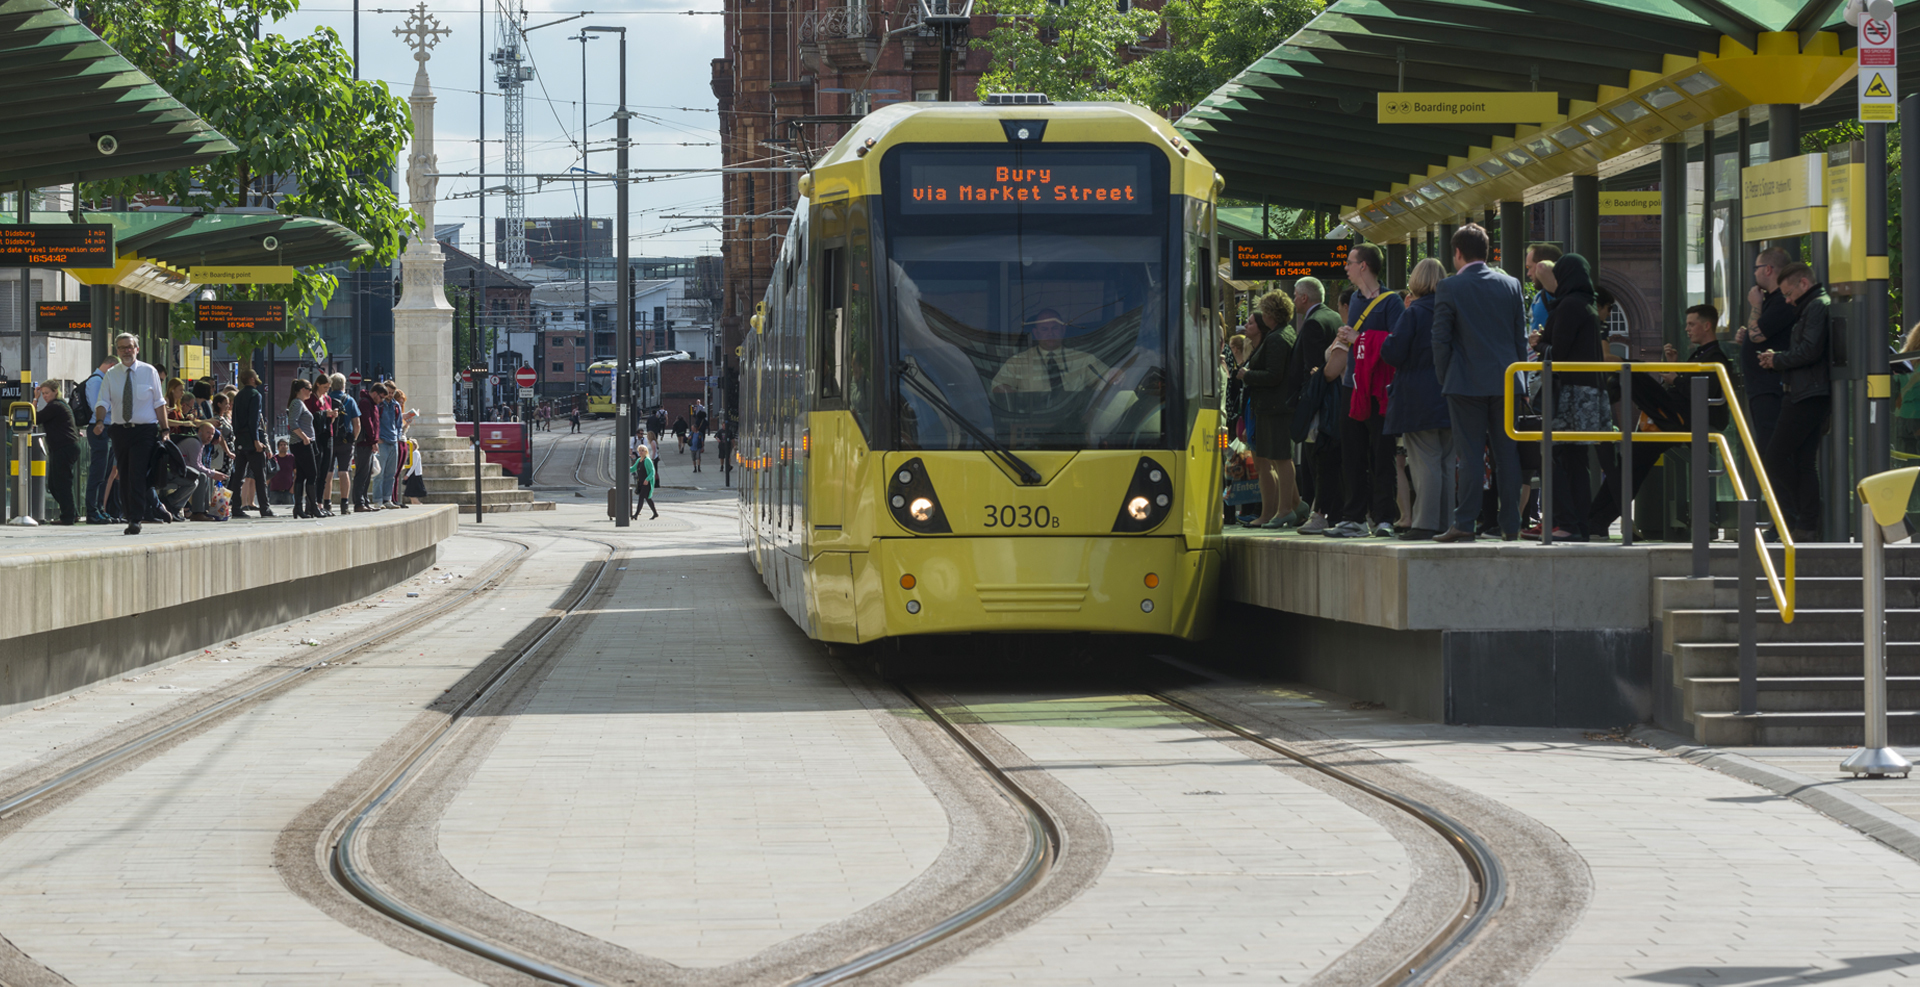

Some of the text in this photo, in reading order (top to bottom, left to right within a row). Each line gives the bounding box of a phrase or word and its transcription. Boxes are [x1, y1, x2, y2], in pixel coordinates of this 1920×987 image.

[1414, 102, 1486, 114] Boarding point
[996, 166, 1051, 183] Bury
[913, 185, 1135, 201] via Market Street
[1614, 199, 1647, 208] Boarding
[5, 230, 36, 238] Didsbury
[5, 238, 36, 246] Didsbury
[1238, 245, 1253, 253] Bury
[29, 254, 67, 263] 16:54:42
[210, 271, 251, 279] Boarding point
[2, 387, 22, 397] PAUL
